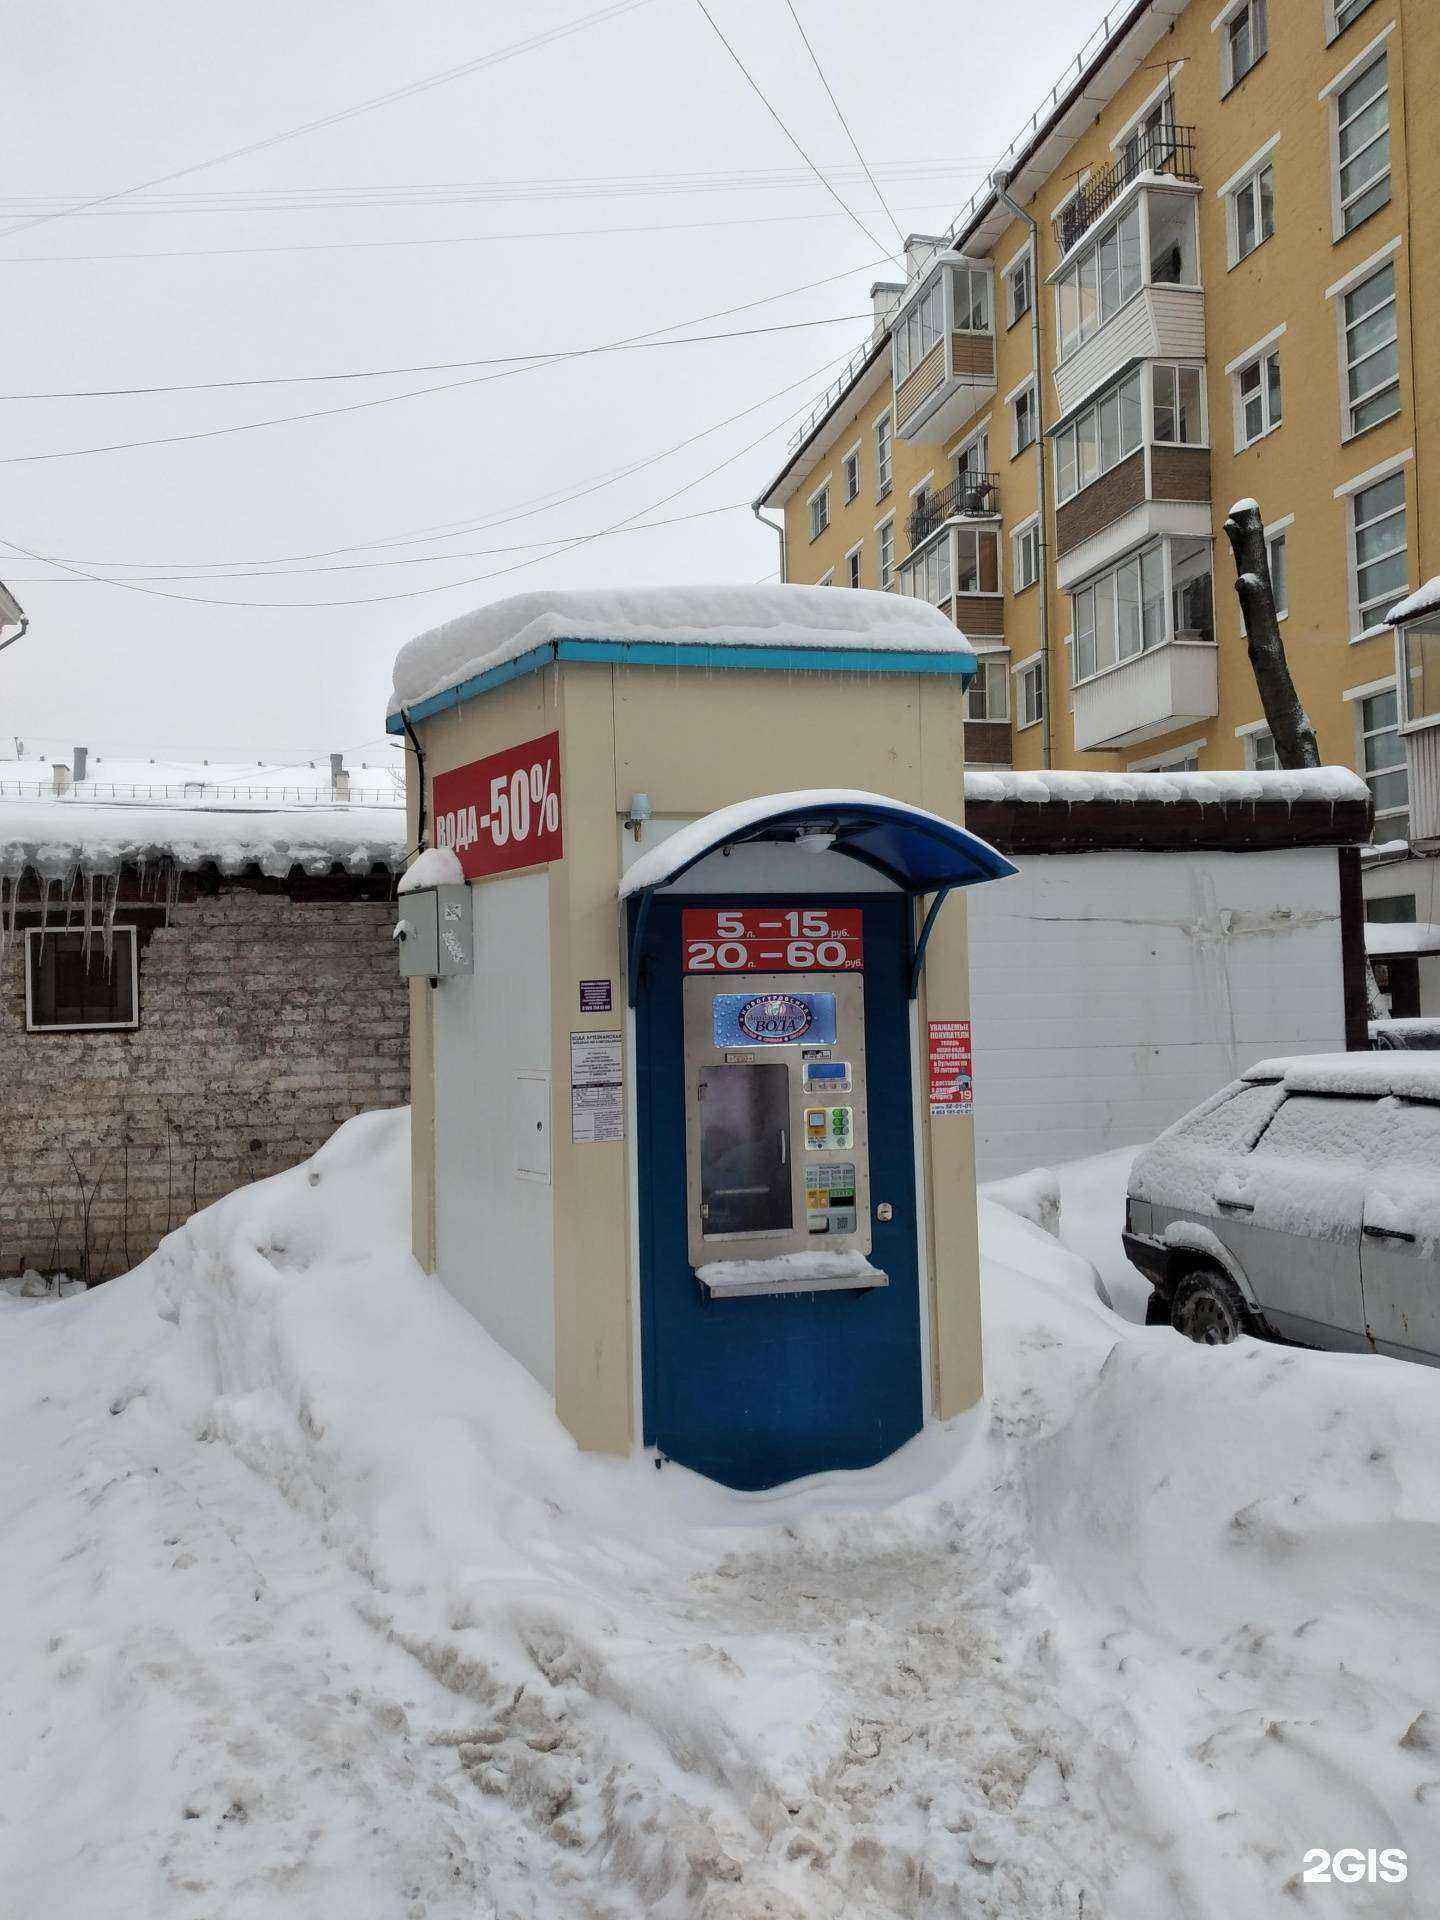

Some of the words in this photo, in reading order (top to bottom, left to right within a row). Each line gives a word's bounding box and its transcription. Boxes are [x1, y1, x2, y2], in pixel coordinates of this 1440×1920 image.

[436, 805, 479, 852] ВОДА
[480, 758, 559, 846] -50%
[755, 1020, 798, 1032] ВОДА
[930, 1023, 969, 1031] УВАЖАЕМЫЕ
[930, 1031, 970, 1039] ПОКУПАТЕЛИ
